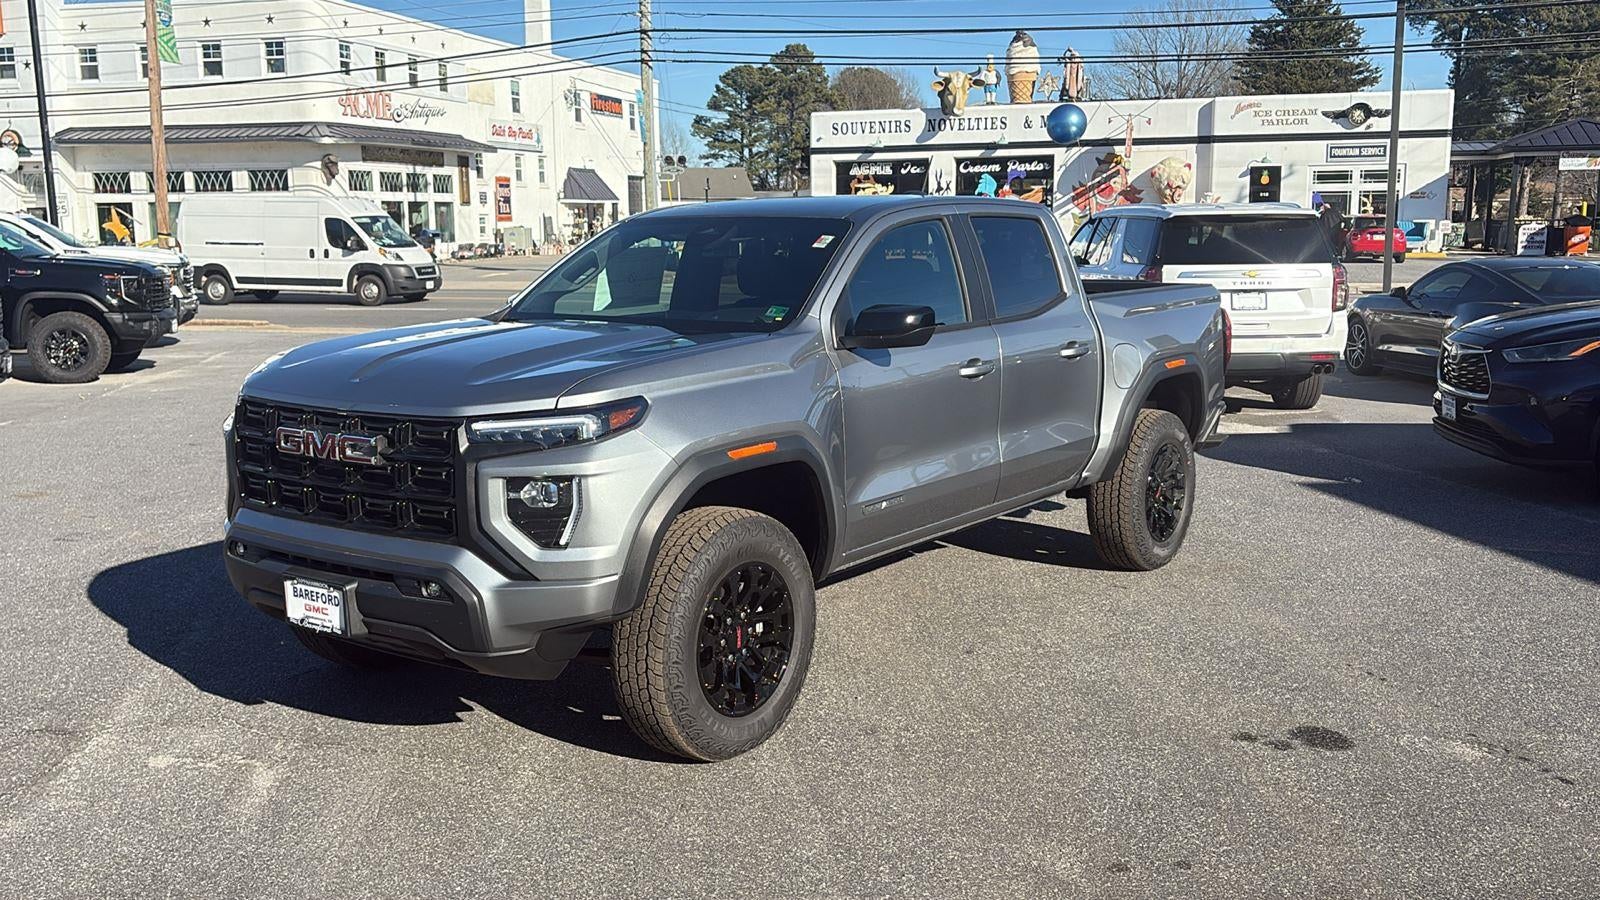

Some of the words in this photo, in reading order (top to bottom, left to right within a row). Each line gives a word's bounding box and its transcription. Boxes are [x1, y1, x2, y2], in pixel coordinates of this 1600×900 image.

[338, 88, 393, 121] ACME
[393, 97, 447, 126] Antiques
[591, 92, 623, 115] Firestone
[1253, 109, 1273, 118] ICE
[1274, 108, 1318, 117] CREAM
[832, 119, 912, 136] SOUVENIRS
[927, 115, 1009, 132] NOVELTIES
[1024, 115, 1034, 129] &
[1261, 118, 1309, 126] PARLOR
[1331, 147, 1360, 157] FOUNTAIN
[1360, 146, 1385, 156] SERVICE
[849, 162, 894, 175] ACME
[901, 161, 926, 174] Ice
[959, 160, 1002, 174] Cream
[1007, 160, 1051, 174] Parlor
[276, 426, 377, 465] GMC
[293, 586, 340, 607] BAREFORD
[304, 603, 329, 616] GMC
